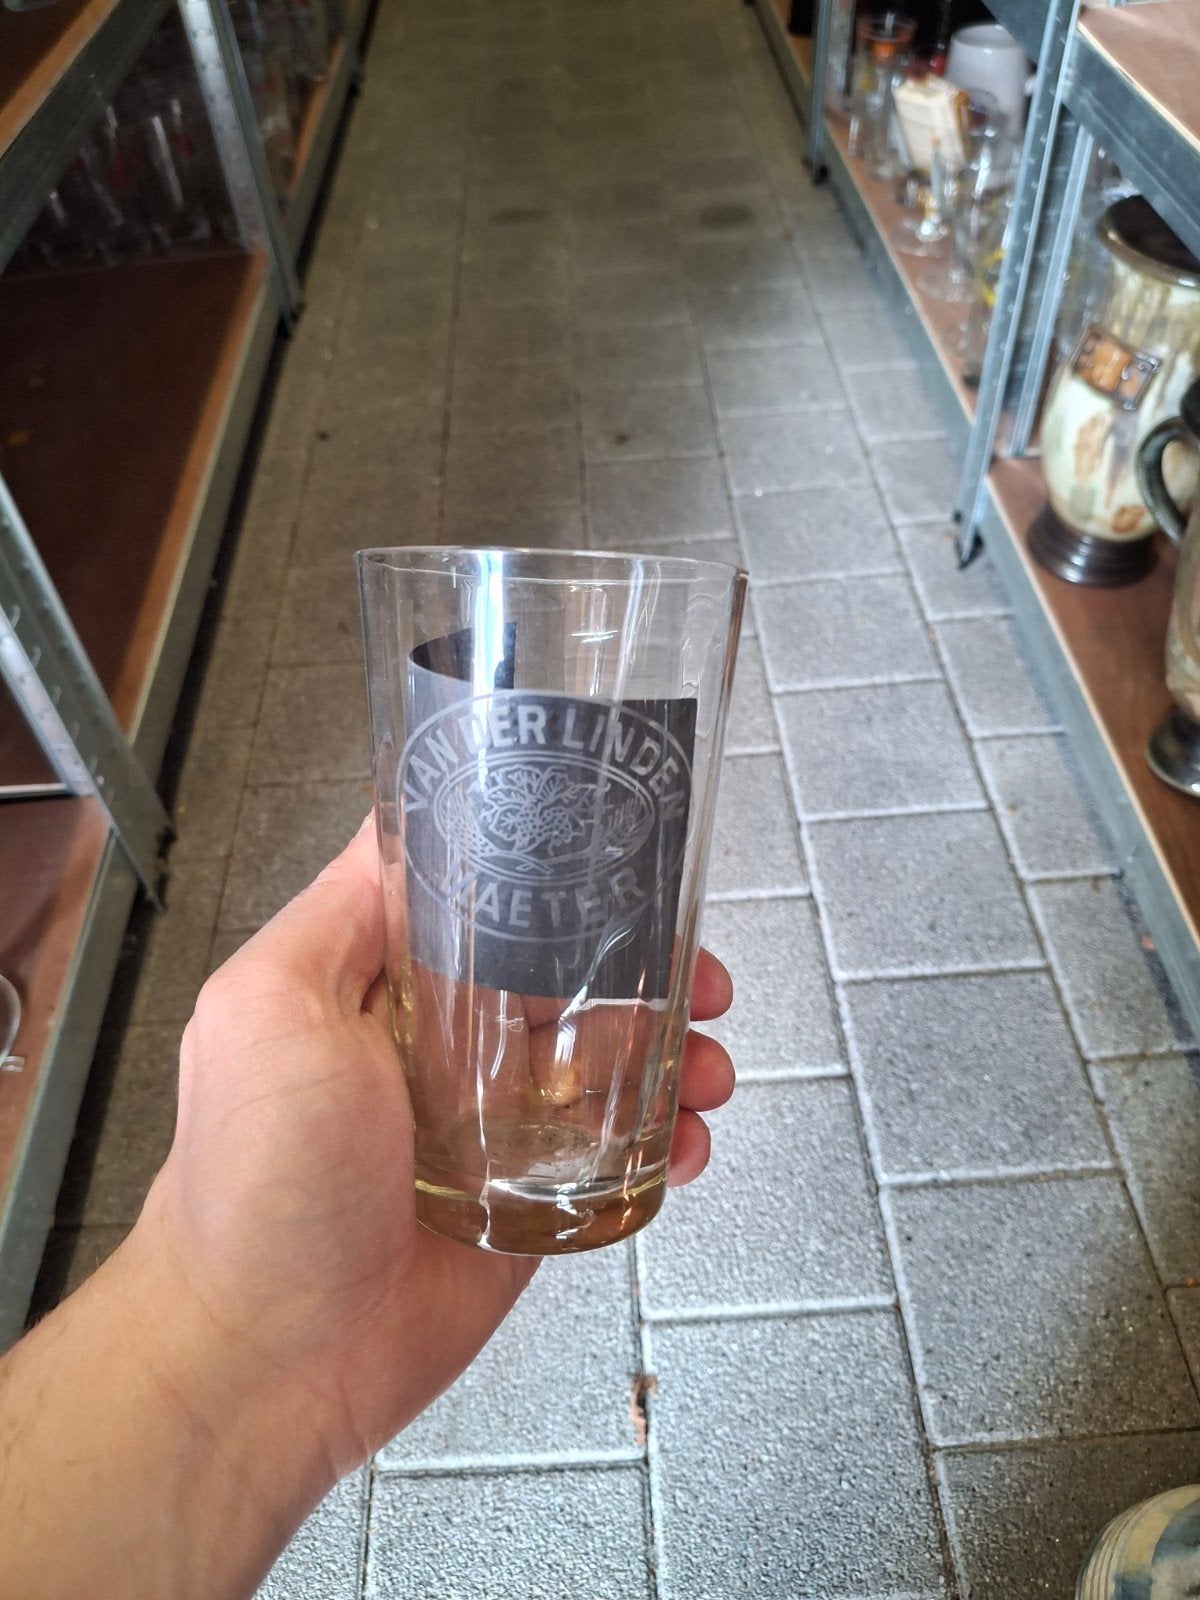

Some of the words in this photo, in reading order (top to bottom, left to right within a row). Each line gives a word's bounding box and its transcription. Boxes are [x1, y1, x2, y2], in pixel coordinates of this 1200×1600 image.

[403, 728, 460, 813] VAN
[459, 704, 547, 752] DER
[561, 704, 686, 822] LINDEN
